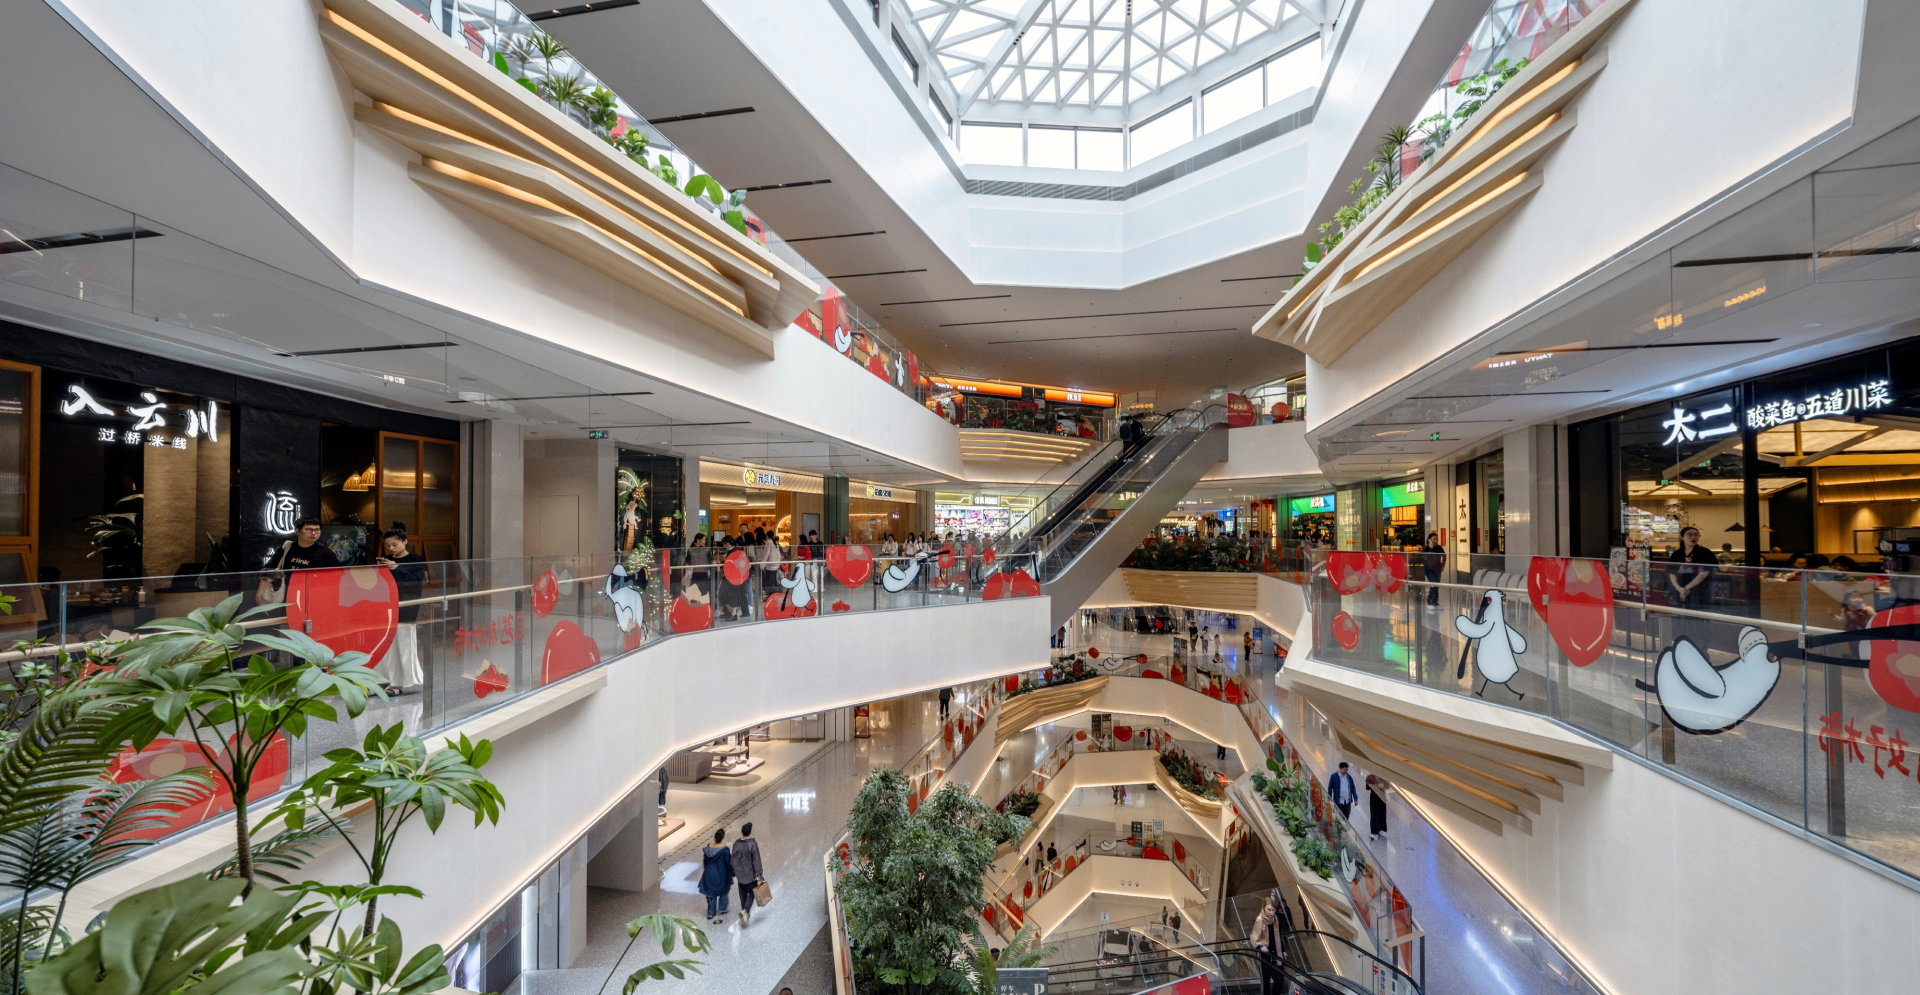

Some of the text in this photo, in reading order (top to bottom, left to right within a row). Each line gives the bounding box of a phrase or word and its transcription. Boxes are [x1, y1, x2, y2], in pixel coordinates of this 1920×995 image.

[60, 384, 218, 443] 入云川
[1662, 403, 1739, 446] 太二
[98, 427, 188, 450] 过桥米线
[1033, 983, 1046, 995] P
